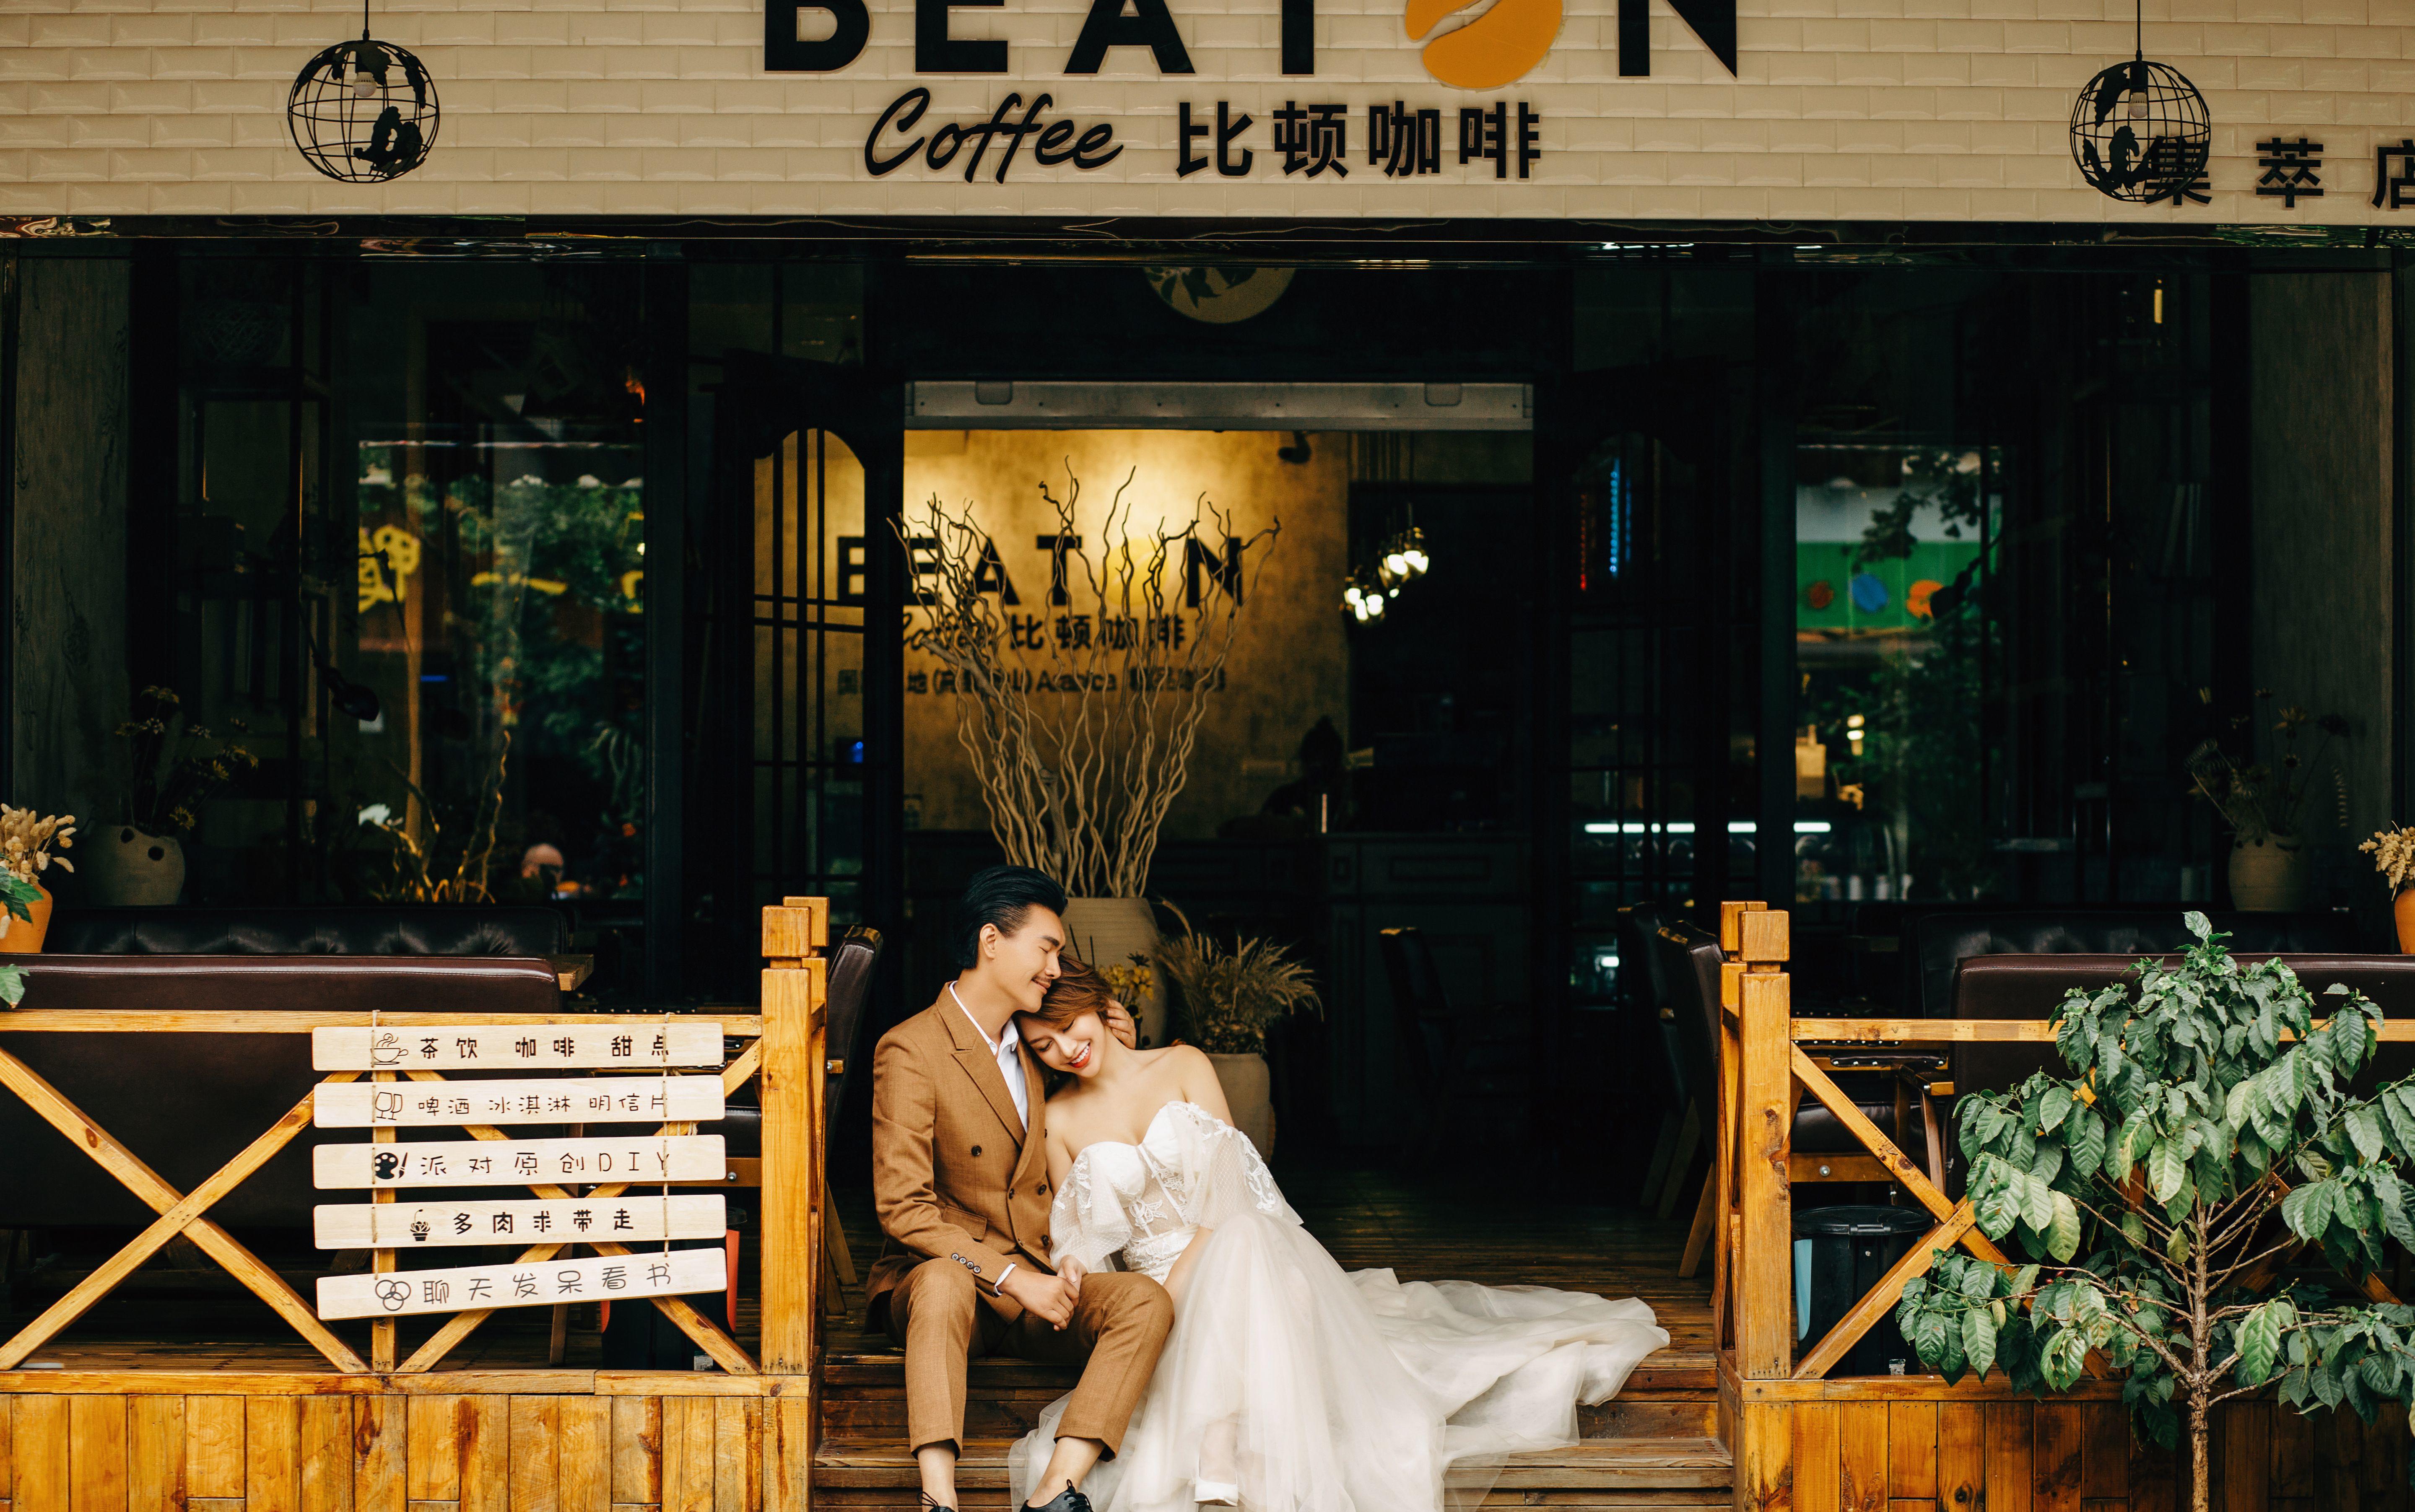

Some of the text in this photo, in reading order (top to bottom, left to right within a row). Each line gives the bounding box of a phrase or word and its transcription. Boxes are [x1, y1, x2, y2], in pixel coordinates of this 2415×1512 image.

[864, 87, 1541, 184] Coffee 比顿咖啡
[420, 1035, 669, 1059] 茶饮 咖啡 甜点
[418, 1093, 667, 1116] 啤酒 冰淇淋 明信片
[453, 1208, 634, 1235] 多肉求带走
[422, 1263, 671, 1305] 聊天发呆看书
